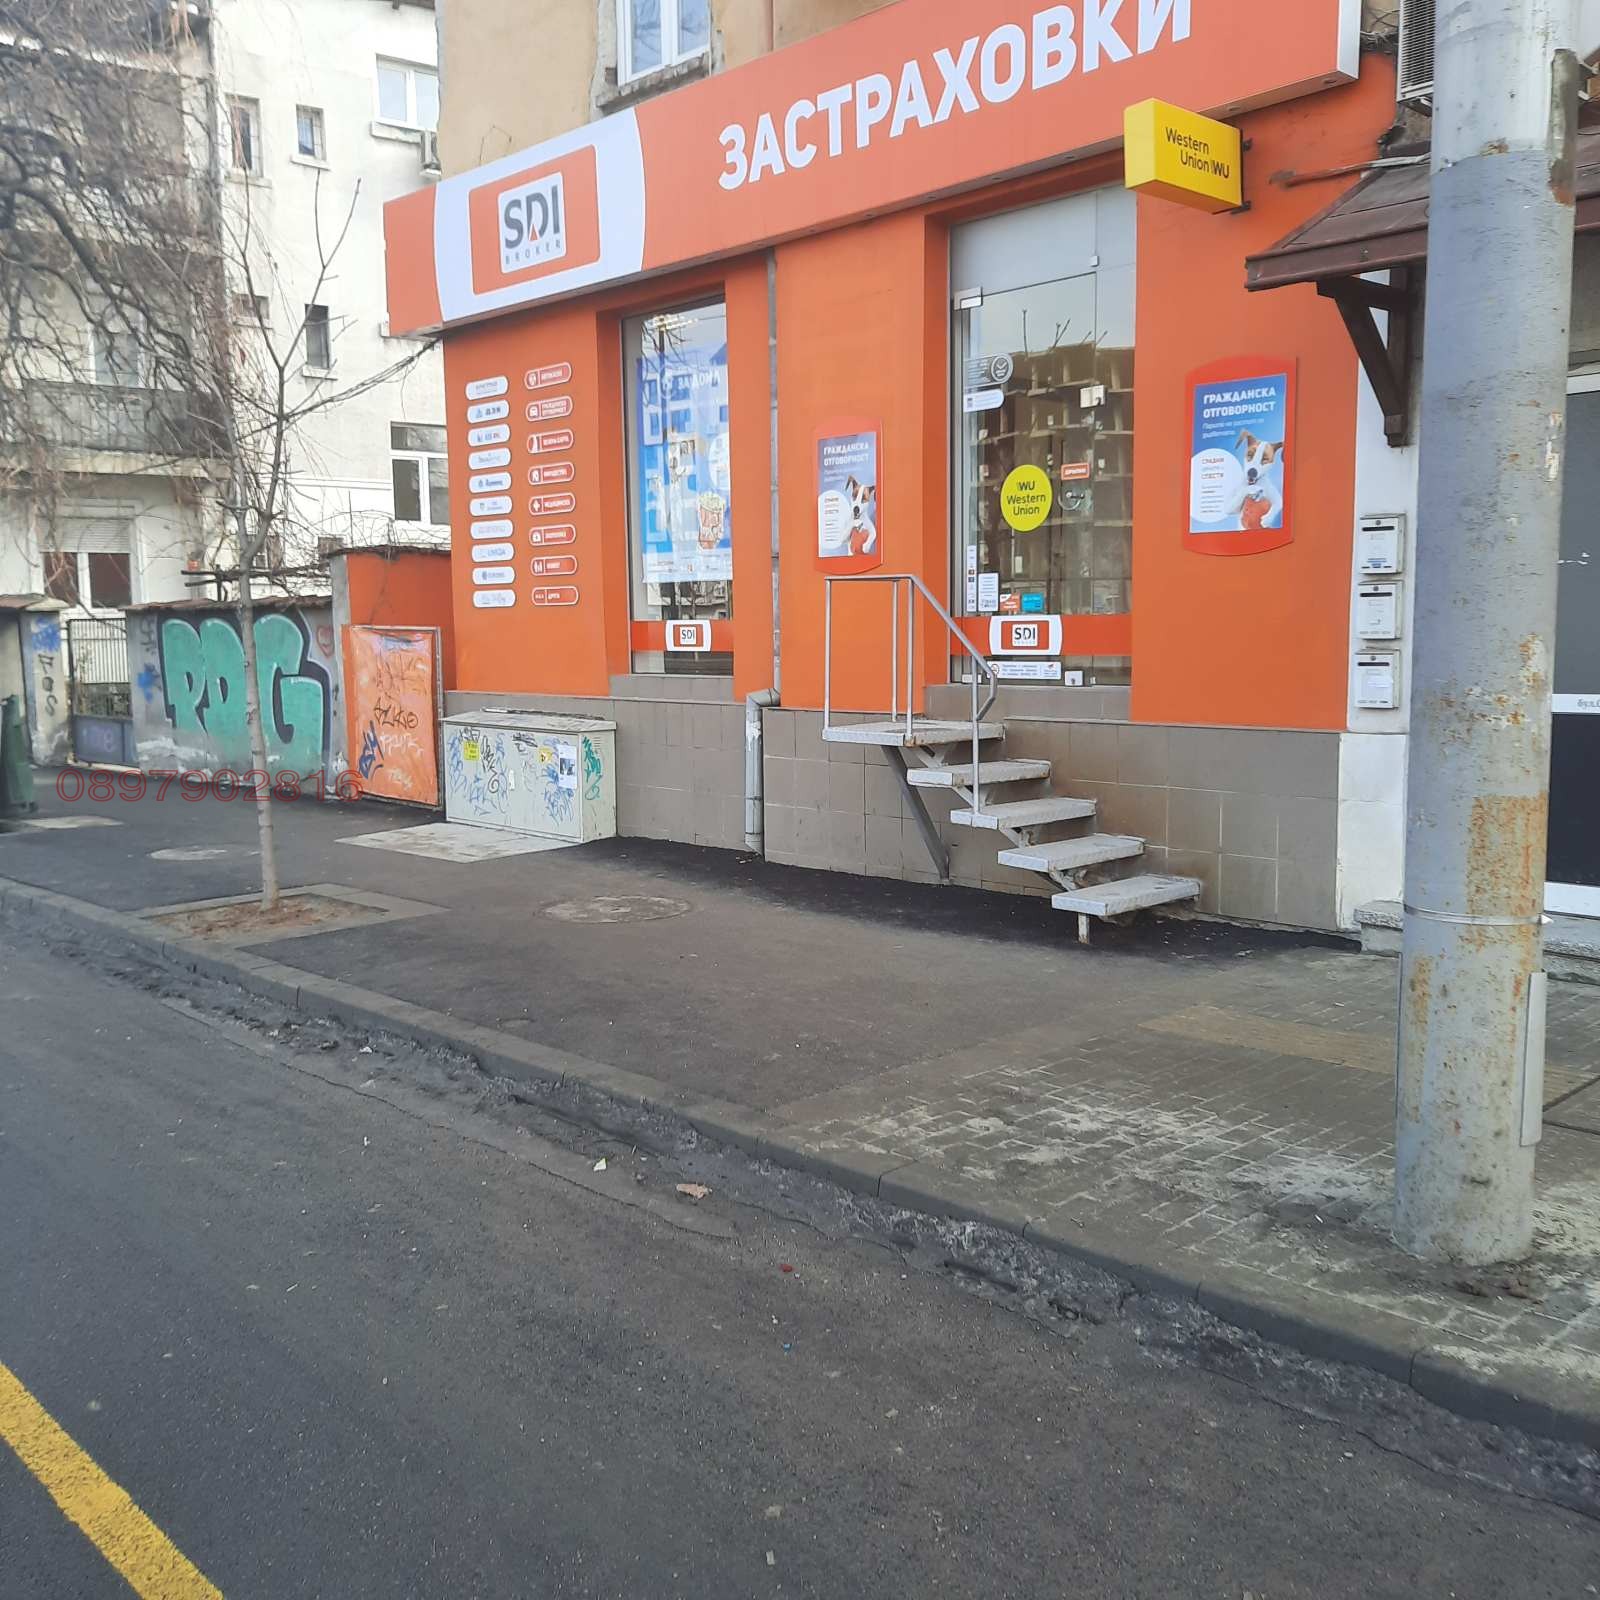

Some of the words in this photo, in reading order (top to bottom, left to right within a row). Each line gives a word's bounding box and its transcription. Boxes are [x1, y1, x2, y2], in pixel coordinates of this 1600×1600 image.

[718, 0, 1192, 190] ЗАСТРАХОВКИ
[1165, 127, 1209, 155] Western
[1180, 150, 1209, 172] Union
[504, 185, 560, 249] SDI
[505, 239, 561, 265] BROKER
[1203, 387, 1276, 404] ГРАЖДАНСКА
[1203, 401, 1276, 419] ОТГОВОРНОСТ
[1017, 482, 1035, 491] WU
[1006, 494, 1046, 505] Western
[1013, 505, 1040, 516] Union
[681, 629, 695, 640] SDI
[1014, 627, 1036, 640] SDI
